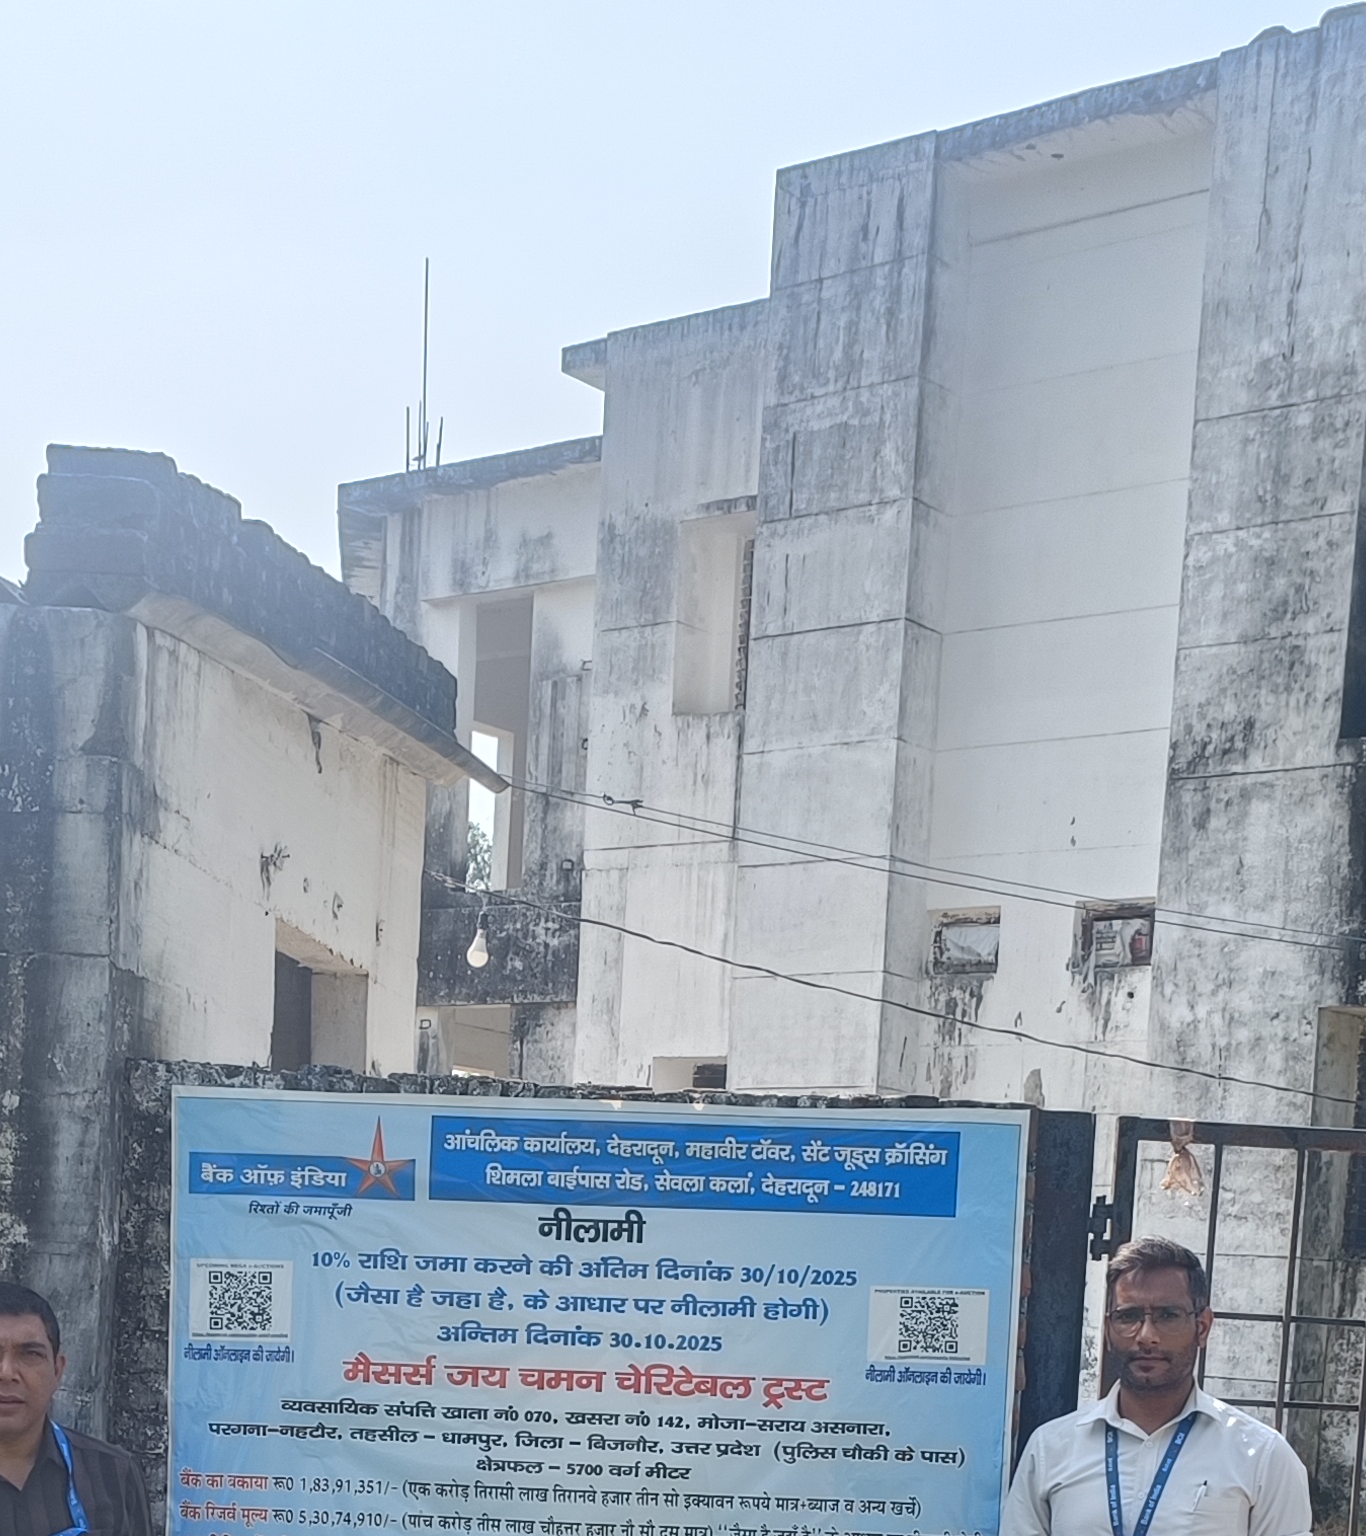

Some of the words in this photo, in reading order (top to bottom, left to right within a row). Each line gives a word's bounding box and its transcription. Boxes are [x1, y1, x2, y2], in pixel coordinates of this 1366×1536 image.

[443, 1129, 520, 1154] आंचलिक
[524, 1131, 601, 1157] कार्यालय,
[606, 1133, 680, 1165] देहरादून,
[685, 1136, 748, 1161] महावीर
[751, 1138, 796, 1164] टॉवर,
[801, 1140, 831, 1163] सेंट
[884, 1142, 949, 1167] क्रॉसिंग
[200, 1162, 234, 1184] बैंक
[240, 1164, 285, 1187] ऑफ़
[290, 1166, 347, 1189] इंडिया
[485, 1162, 543, 1187] शिमला
[546, 1165, 612, 1191] बाईपास
[615, 1168, 649, 1192] रोड,
[654, 1168, 705, 1193] सेवला
[709, 1172, 756, 1196] कलां,
[761, 1172, 831, 1204] देहरादून
[850, 1180, 901, 1199] 248171
[248, 1200, 281, 1214] रिश्तों
[283, 1201, 300, 1215] की
[537, 1206, 647, 1244] नीलामी
[311, 1251, 351, 1269] 10%
[358, 1247, 408, 1271] राशि
[414, 1254, 467, 1273] जमा
[473, 1252, 533, 1276] करने
[539, 1254, 573, 1278] की
[578, 1256, 649, 1280] अंतिम
[656, 1258, 734, 1282] दिनांक
[740, 1264, 858, 1289] 30/10/2025
[335, 1281, 400, 1309] (जैसा
[406, 1283, 425, 1308] है
[431, 1290, 481, 1310] जहा
[487, 1286, 515, 1312] है,
[523, 1289, 550, 1311] के
[555, 1295, 628, 1315] आधार
[633, 1299, 666, 1316] पर
[670, 1293, 757, 1319] नीलामी
[763, 1297, 830, 1327] होगी)
[436, 1319, 519, 1345] अन्तिम
[525, 1322, 603, 1348] दिनांक
[609, 1332, 723, 1352] 30.10.2025
[342, 1351, 437, 1386] मैसर्स
[443, 1365, 510, 1389] जय
[518, 1367, 607, 1393] चमन
[614, 1363, 756, 1399] चेरिटेबल
[761, 1377, 831, 1410] ट्रस्ट
[865, 1364, 896, 1383] नीलामी
[897, 1366, 938, 1386] ऑनलाइन
[940, 1367, 952, 1385] की
[281, 1398, 379, 1416] व्यवसायिक
[384, 1400, 437, 1418] संपत्ति
[441, 1406, 490, 1421] खाता
[524, 1410, 559, 1425] 070,
[565, 1411, 621, 1427] खसरा
[657, 1416, 691, 1431] 142,
[810, 1419, 892, 1438] असनारा,
[349, 1425, 420, 1443] तहसील
[441, 1431, 508, 1452] धामपुर,
[515, 1431, 564, 1449] जिला
[586, 1433, 664, 1455] बिजनौर,
[671, 1441, 711, 1456] उत्तर
[716, 1440, 761, 1458] प्रदेश
[773, 1440, 837, 1464] (पुलिस
[842, 1443, 889, 1461] चौकी
[894, 1446, 915, 1463] के
[920, 1447, 966, 1468] पास)
[476, 1455, 545, 1475] क्षेत्रफल
[566, 1463, 603, 1477] 5700
[609, 1461, 641, 1478] वर्ग
[645, 1463, 692, 1480] मीटर
[180, 1467, 202, 1488] बैंक
[206, 1474, 223, 1489] का
[402, 1479, 431, 1500] (एक
[434, 1478, 470, 1502] करोड़
[473, 1480, 514, 1501] तिरासी
[518, 1487, 549, 1503] लाख
[552, 1484, 597, 1505] तिरानवे
[600, 1490, 632, 1508] हजार
[636, 1486, 659, 1507] तीन
[683, 1493, 735, 1511] इक्यावन
[738, 1491, 771, 1511] रूपये
[844, 1499, 855, 1514] व
[858, 1500, 886, 1515] अन्य
[179, 1500, 202, 1520] बैंक
[205, 1501, 237, 1521] रिजर्व
[241, 1508, 269, 1528] मूल्य
[401, 1511, 434, 1532] (पांच
[438, 1511, 473, 1534] करोड़
[476, 1512, 502, 1533] तीस
[505, 1519, 535, 1535] लाख
